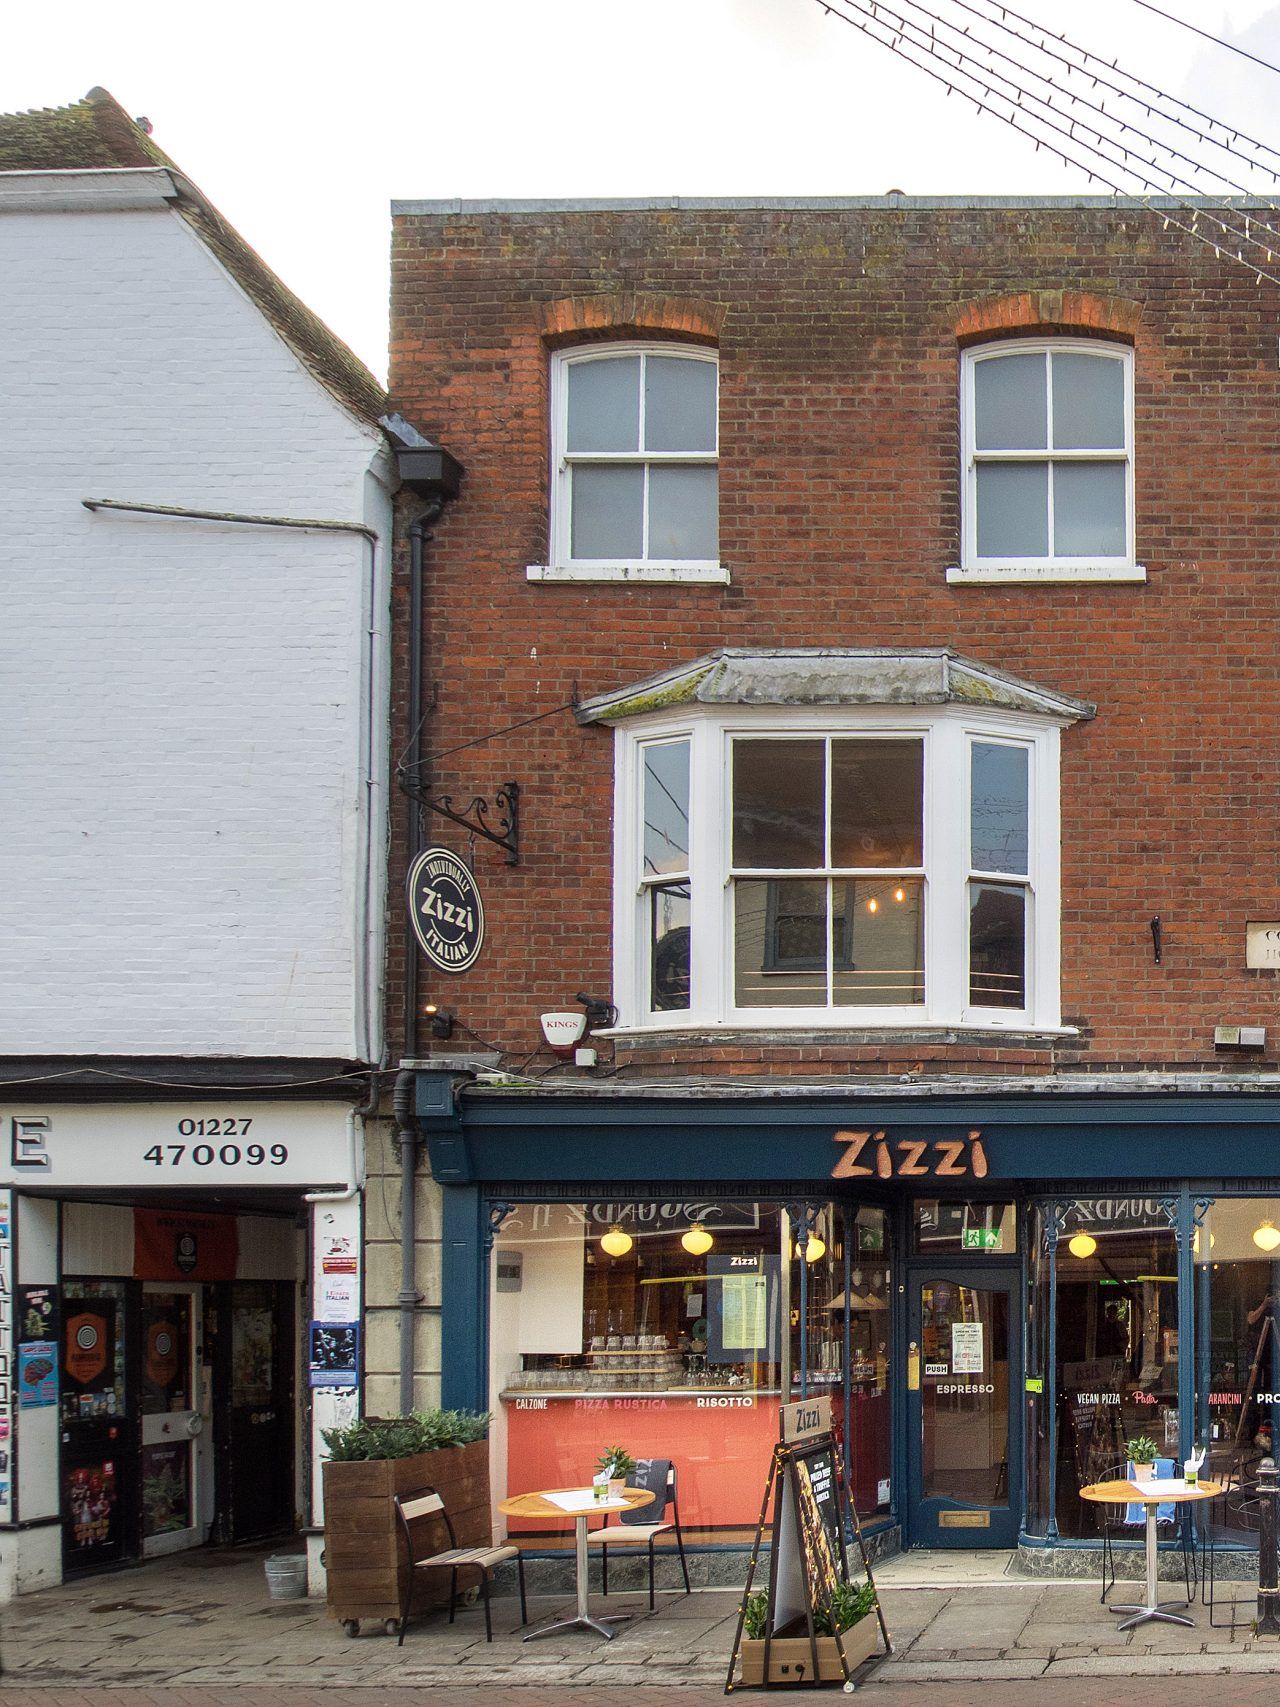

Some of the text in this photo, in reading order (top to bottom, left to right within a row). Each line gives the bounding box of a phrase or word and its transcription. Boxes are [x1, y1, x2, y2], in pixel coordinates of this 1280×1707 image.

[425, 860, 471, 893] INDIVIDUALLY
[421, 886, 474, 933] Zizzi
[425, 928, 469, 961] ITALIAN
[178, 1118, 253, 1136] 01227
[143, 1144, 289, 1166] 470099
[831, 1130, 988, 1179] Zizzi
[730, 1256, 758, 1266] Zizzi
[926, 1365, 947, 1373] PUSH
[936, 1384, 995, 1394] ESPRESSO
[1077, 1390, 1159, 1405] VEGAN PIZZA Pasta
[515, 1397, 753, 1410] CALZONE PIZZA RUSTICA RISOTTO
[1207, 1393, 1242, 1405] ARANCINI
[796, 1405, 820, 1434] Zizzi
